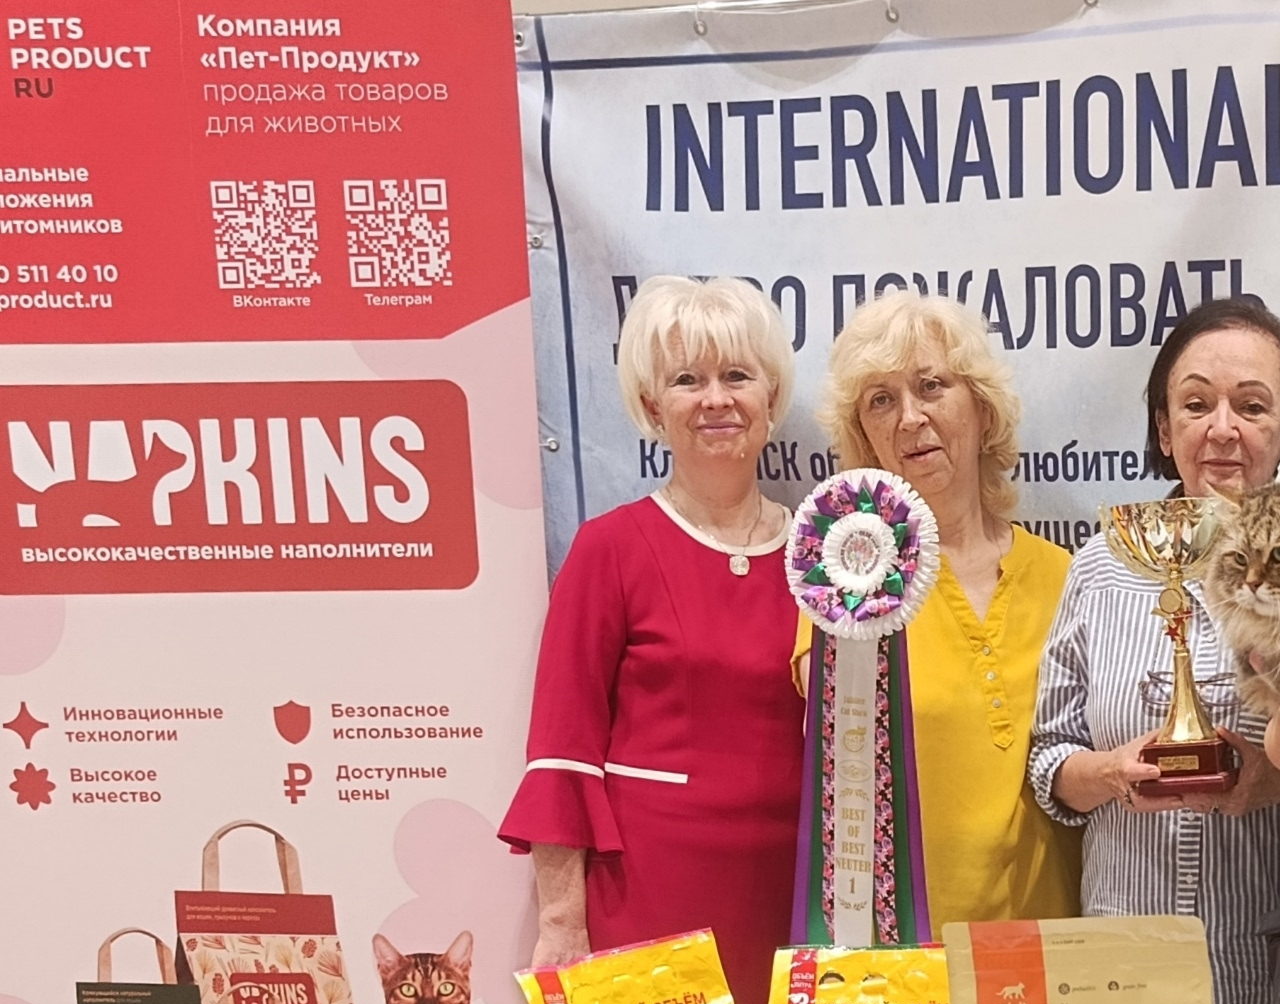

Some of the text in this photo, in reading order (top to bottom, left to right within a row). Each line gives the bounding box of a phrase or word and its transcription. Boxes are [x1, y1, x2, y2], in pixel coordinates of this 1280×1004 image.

[8, 17, 83, 40] PETS
[198, 15, 341, 37] Компания
[11, 46, 151, 69] PRODUCT
[200, 46, 420, 73] «Пет-Продукт»
[14, 78, 54, 98] RU
[204, 80, 448, 104] продажа товаров
[205, 113, 402, 136] для животных
[17, 264, 118, 283] 511 40 10
[233, 295, 311, 308] ВКонтакте
[364, 294, 433, 306] Телеграм
[832, 258, 1266, 350] ПАЛОВАТЬ
[8, 415, 430, 528] NAPKINS
[22, 541, 433, 563] высококачественные наполнители
[63, 705, 223, 724] Инновационные
[331, 703, 450, 719] Безопасное
[65, 727, 178, 743] технологии
[333, 724, 483, 740] использование
[70, 767, 157, 783] Высокое
[336, 764, 447, 783] Доступные
[72, 788, 162, 805] качество
[339, 786, 390, 803] цены
[841, 808, 867, 821] BEST
[847, 825, 860, 838] OF
[841, 842, 866, 855] BEST
[835, 857, 871, 872] NEUTER
[849, 877, 856, 894] 1
